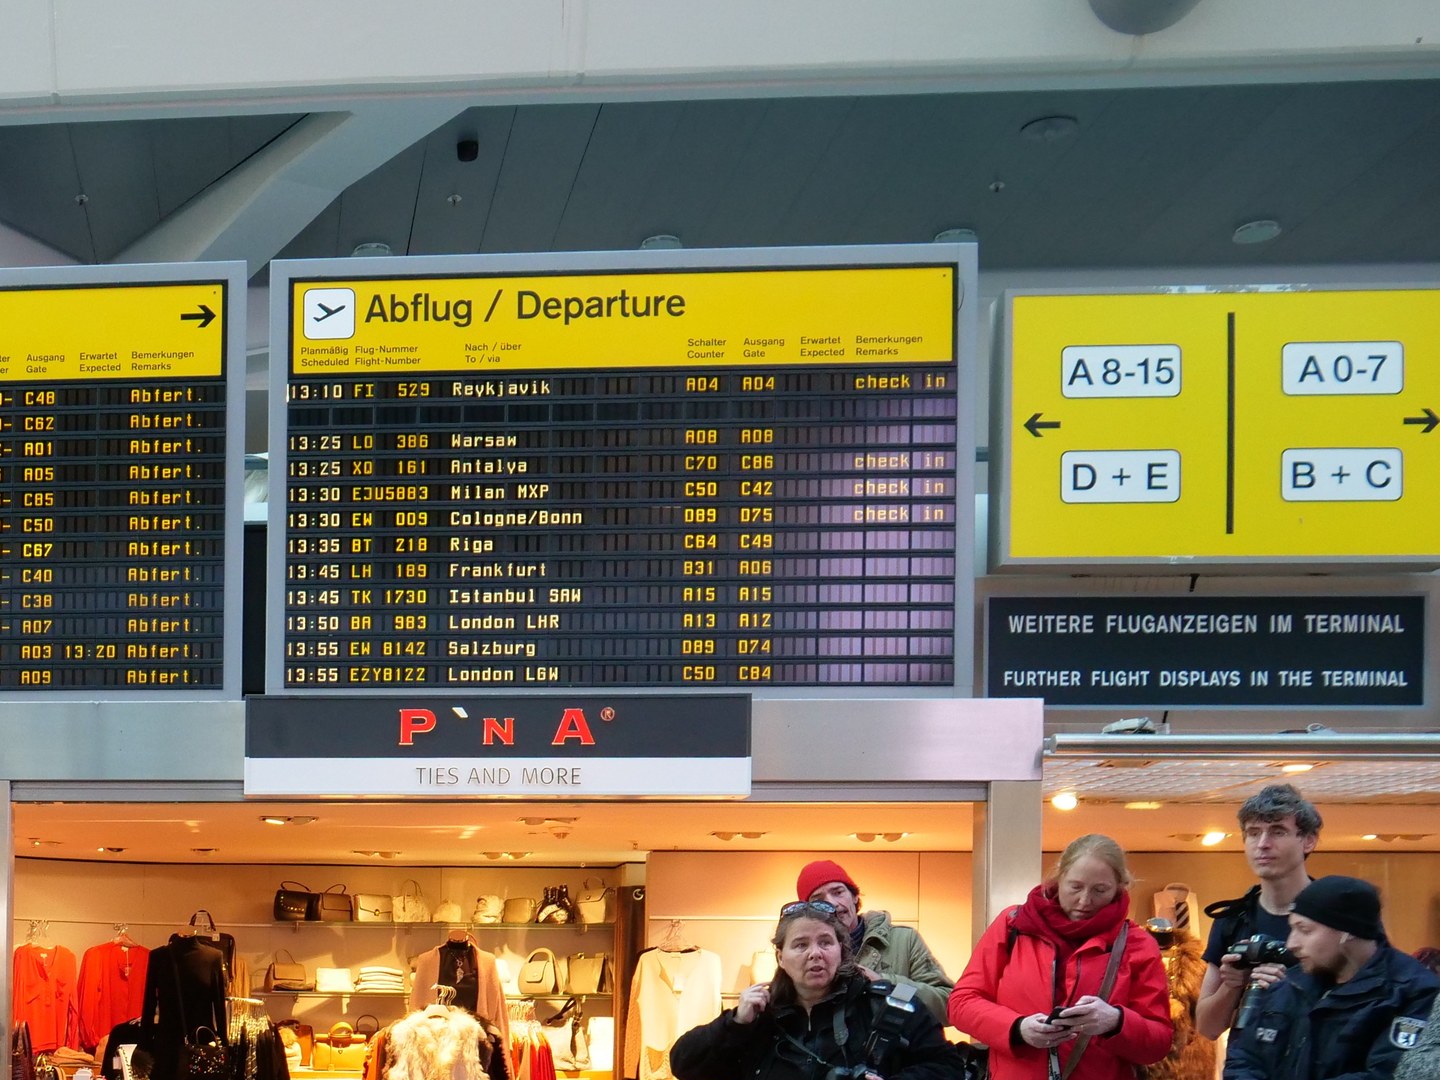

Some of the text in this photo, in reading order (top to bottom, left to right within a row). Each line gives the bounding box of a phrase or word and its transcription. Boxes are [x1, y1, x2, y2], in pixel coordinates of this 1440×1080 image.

[364, 292, 472, 328] Abflug
[517, 289, 686, 325] Departure
[26, 353, 66, 363] Ausgang
[79, 351, 118, 361] Erwartet
[131, 350, 195, 360] Bemerkungen
[25, 364, 47, 374] Gate
[79, 363, 122, 374] Expected
[131, 362, 172, 371] Remarks
[1067, 357, 1175, 386] A 8-15
[1298, 354, 1387, 383] A 0-7
[291, 380, 551, 399] 13:10 Reykjavik
[290, 433, 517, 450] 13:25 Warsaw
[290, 458, 527, 476] 13:25 Antalya
[1292, 461, 1316, 489] B
[1366, 460, 1391, 489] C
[1072, 463, 1097, 491] D
[1147, 462, 1168, 490] E
[290, 484, 549, 502] 13:30 Milan MXP
[289, 510, 582, 528] 13:30 Cologne/Bonn
[289, 537, 493, 554] 13:35 Riga
[289, 562, 546, 579] 13:45 Frankfurt
[288, 590, 339, 605] 13:45
[449, 588, 535, 604] Istanbul
[288, 614, 559, 631] 13:50 London LHR
[1008, 614, 1405, 634] WEITERE FLUGANZEIGEN IM TERMINAL
[287, 641, 536, 657] 13:55 Salzburg
[287, 667, 338, 682] 13:55
[448, 667, 514, 682] London
[1004, 670, 1408, 687] FURTHER FLIGHT DISPLAYS IN THE TERMINAL
[415, 767, 582, 785] TIES AND MORE
